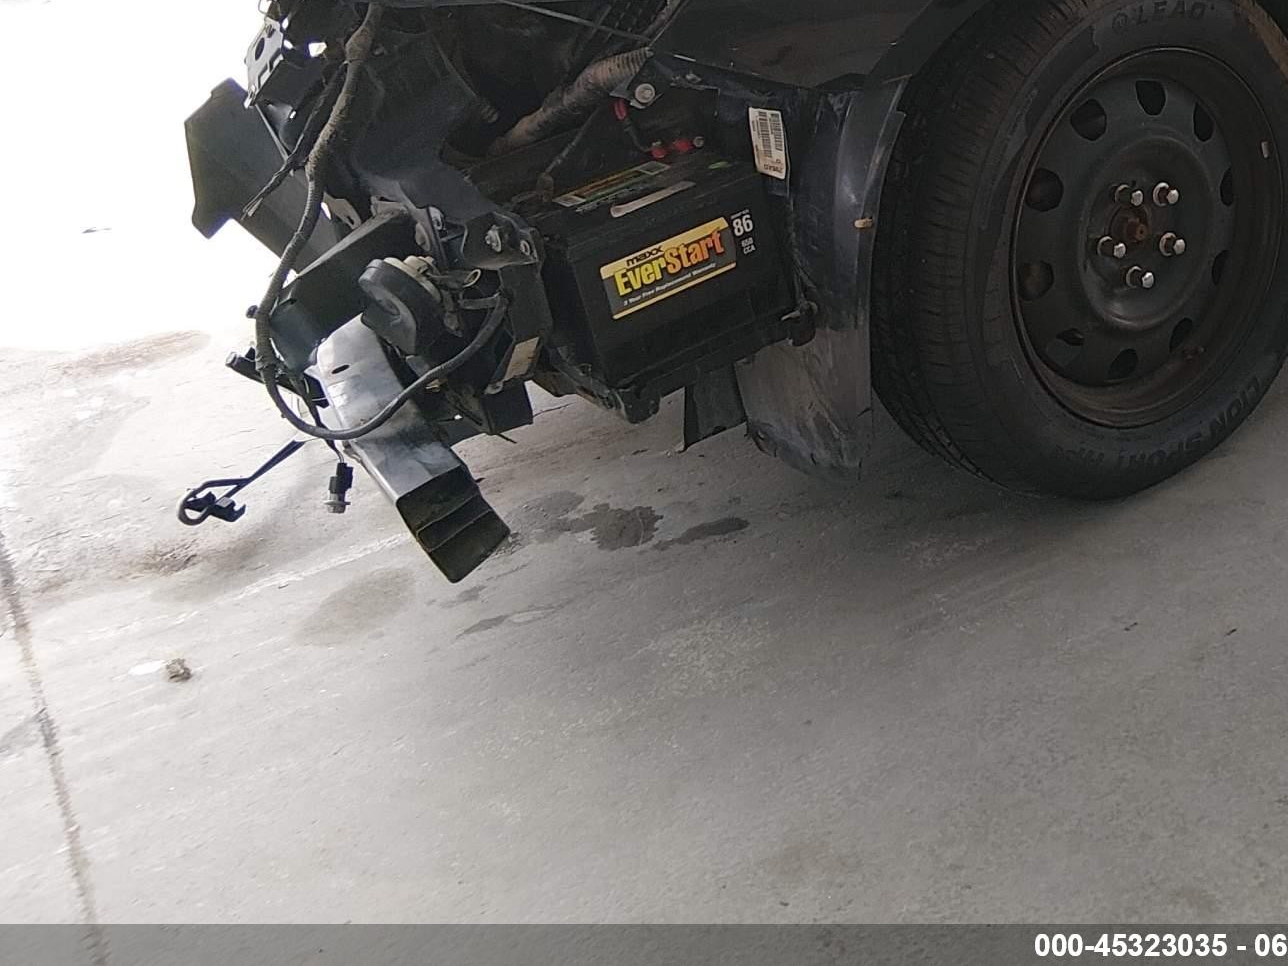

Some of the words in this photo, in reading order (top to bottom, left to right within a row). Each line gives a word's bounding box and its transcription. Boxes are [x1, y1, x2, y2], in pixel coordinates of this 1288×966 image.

[732, 214, 753, 236] 86
[614, 231, 725, 296] EverStart
[627, 246, 664, 267] maxx
